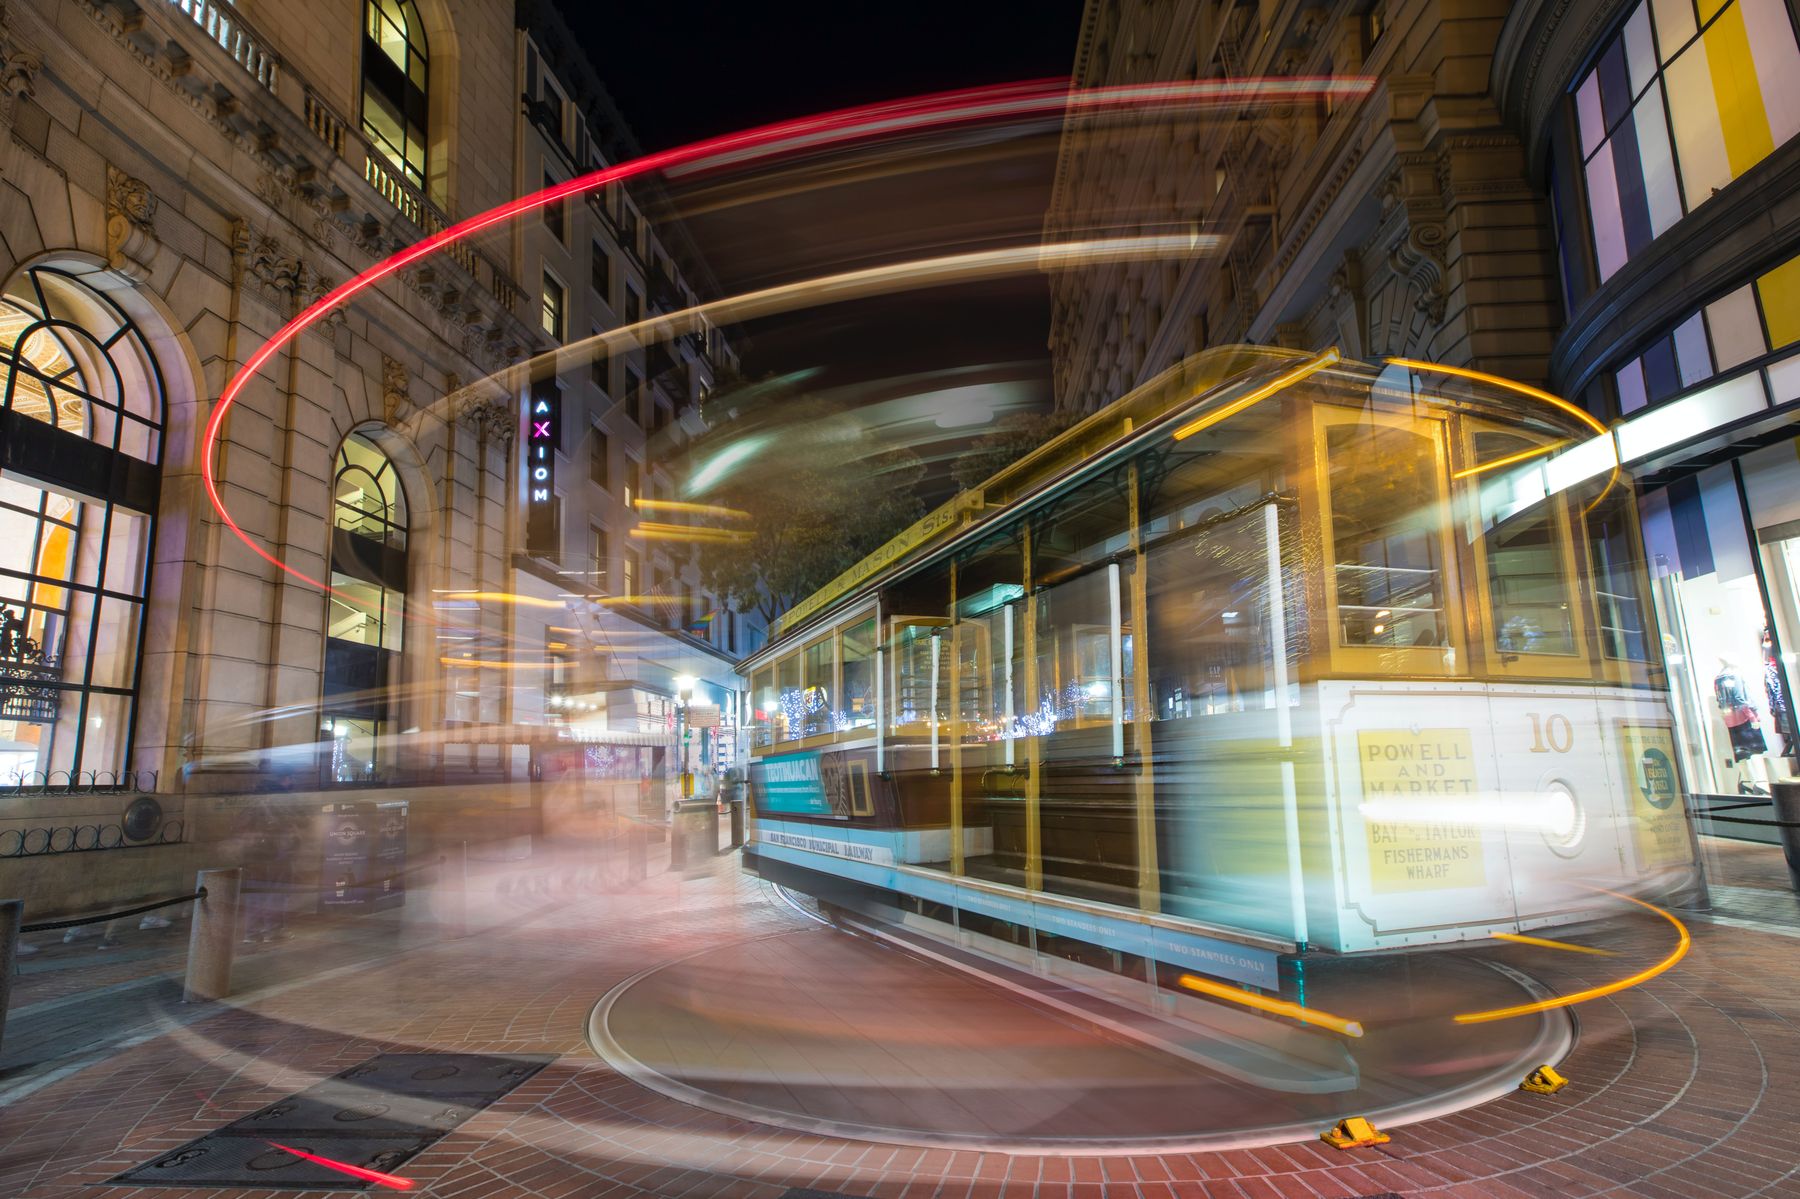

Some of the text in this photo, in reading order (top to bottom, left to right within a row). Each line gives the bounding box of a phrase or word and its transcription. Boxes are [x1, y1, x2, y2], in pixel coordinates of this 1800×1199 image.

[533, 401, 551, 502] AXIOM
[851, 533, 910, 583] MASON
[921, 510, 953, 536] Sts.
[1526, 712, 1573, 753] 10
[1367, 743, 1467, 762] POWELL
[1398, 763, 1446, 778] AND
[1370, 779, 1472, 797] MARKET
[1371, 822, 1398, 844] BAY
[780, 834, 806, 849] FRANCISCO
[809, 839, 840, 855] MUNICIPAL
[844, 844, 873, 862] RAILWAY
[1383, 845, 1469, 865] FISHERMANS
[1406, 863, 1450, 880] WHARF
[1169, 943, 1265, 972] TWO STANDEES ONLY
